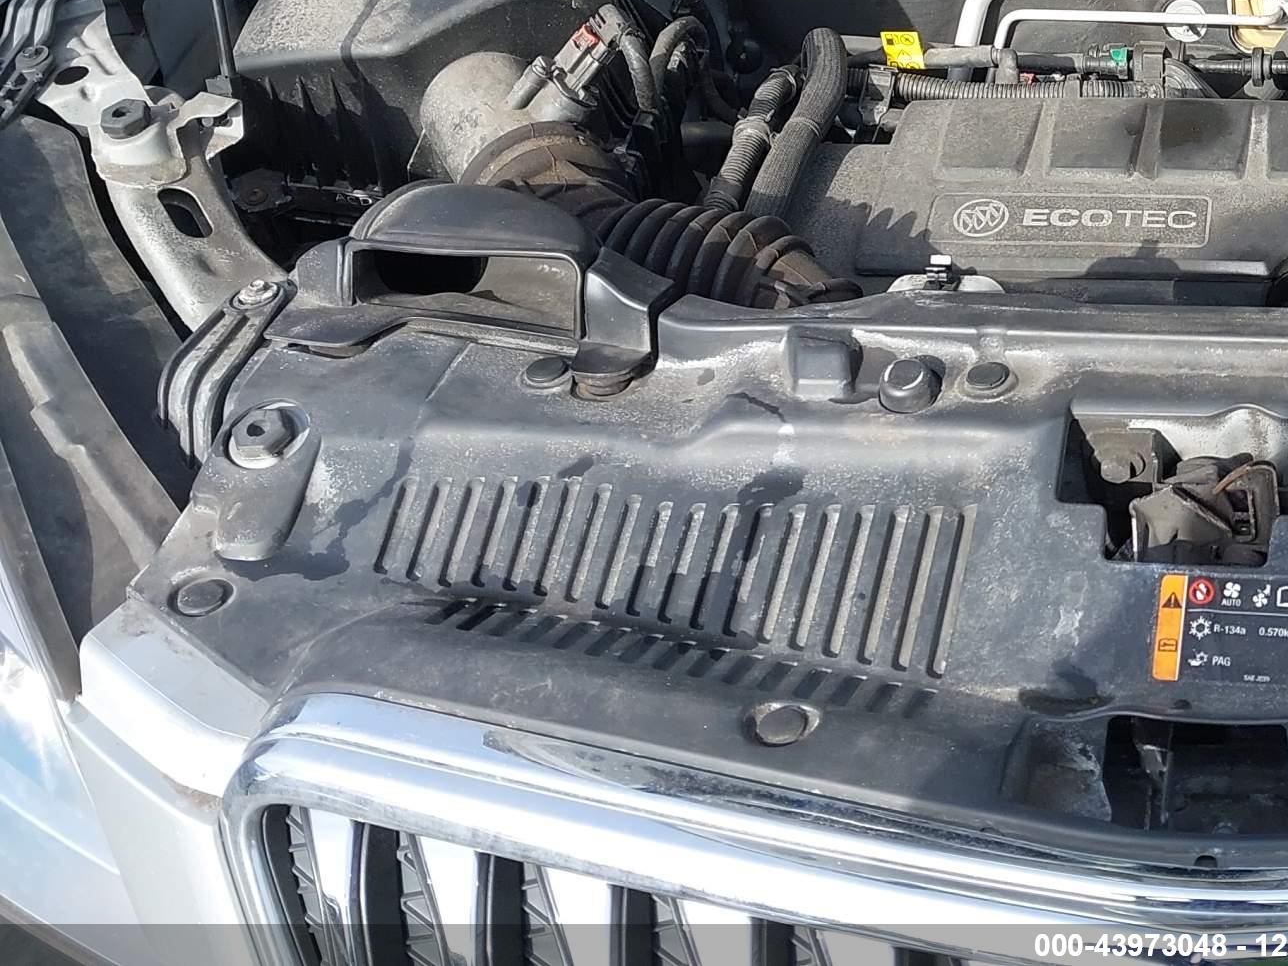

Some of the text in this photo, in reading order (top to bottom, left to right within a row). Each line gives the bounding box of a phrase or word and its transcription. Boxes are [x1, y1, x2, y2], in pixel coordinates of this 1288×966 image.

[1022, 208, 1198, 229] ECOTEC
[1221, 598, 1242, 607] AUTO
[1213, 623, 1247, 635] R-134a
[1211, 655, 1231, 666] PAG
